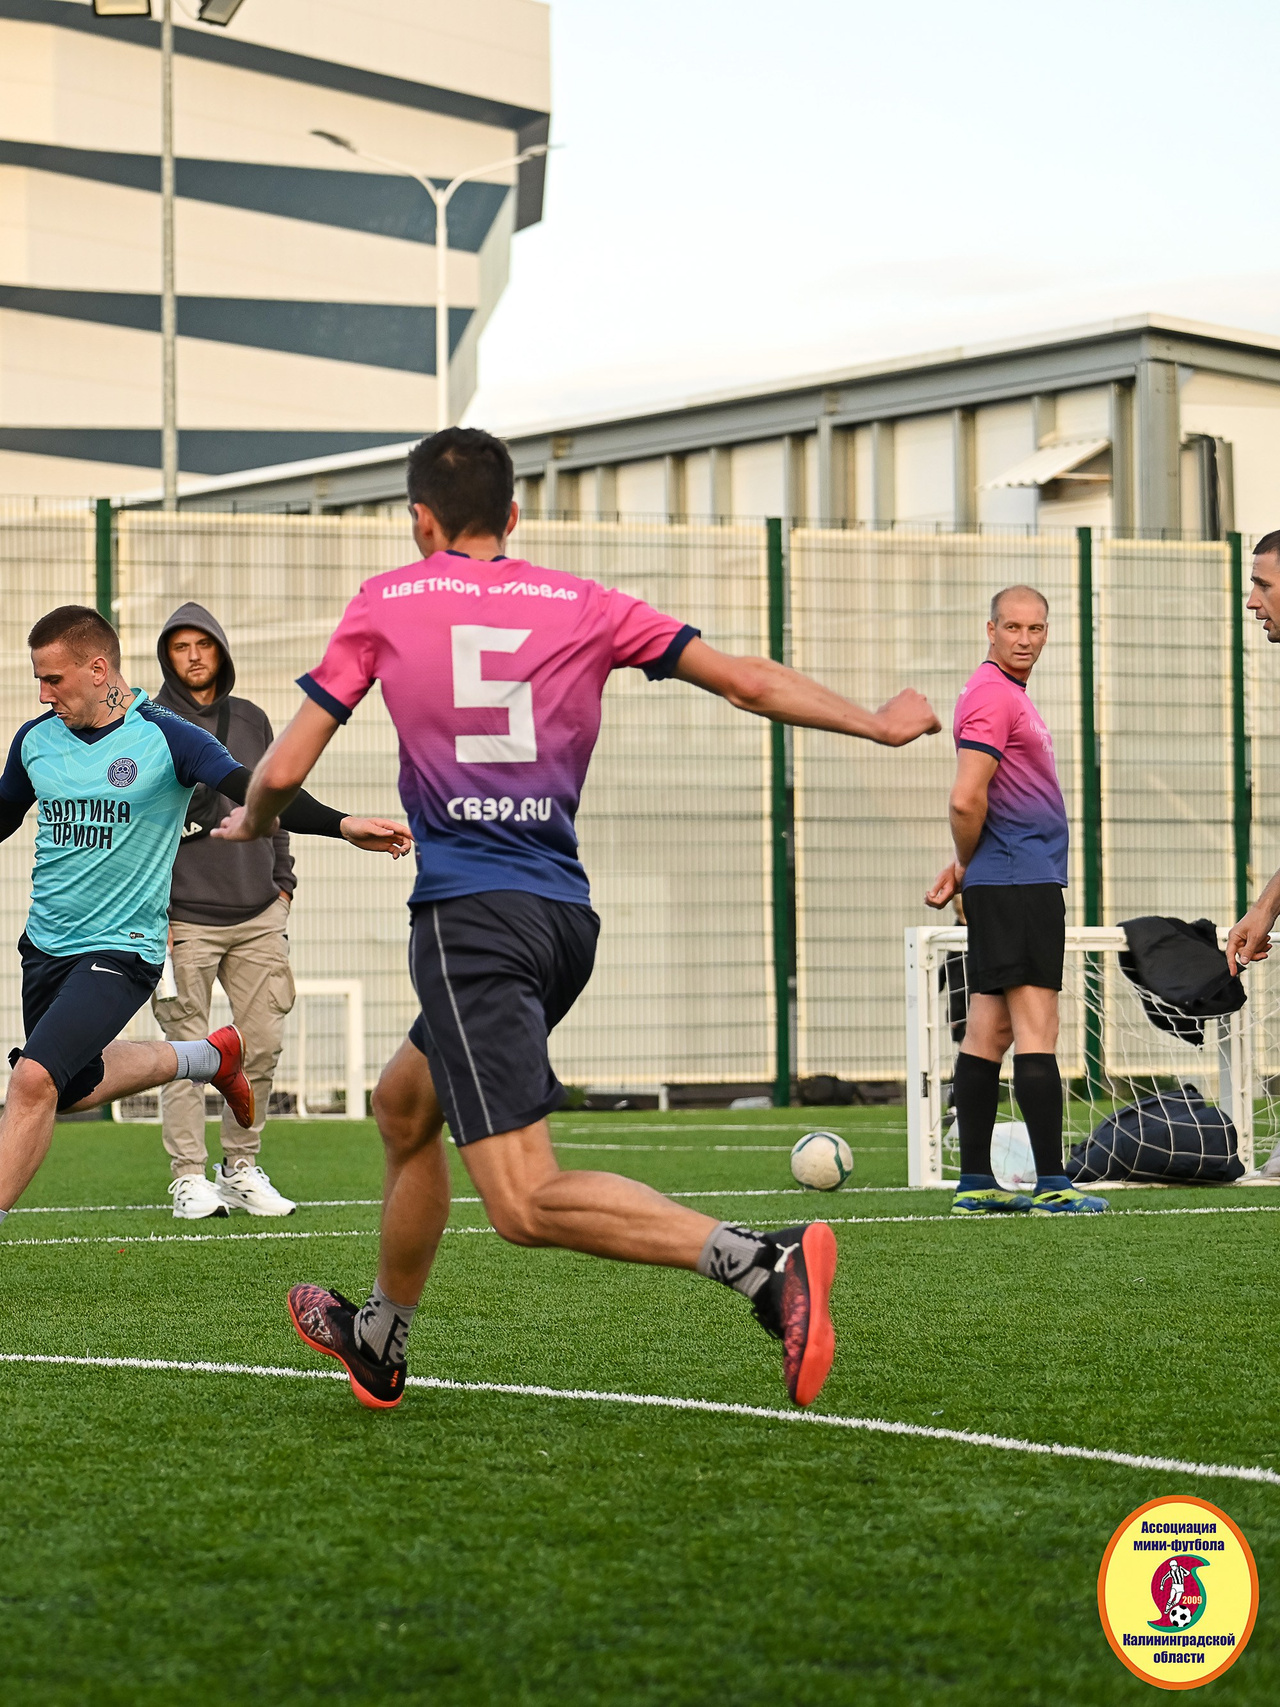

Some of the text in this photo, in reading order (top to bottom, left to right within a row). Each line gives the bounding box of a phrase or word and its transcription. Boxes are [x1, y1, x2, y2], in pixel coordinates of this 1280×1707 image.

[451, 624, 537, 763] 5
[42, 799, 131, 823] БАЛТИКА
[52, 823, 113, 850] ОРИОН
